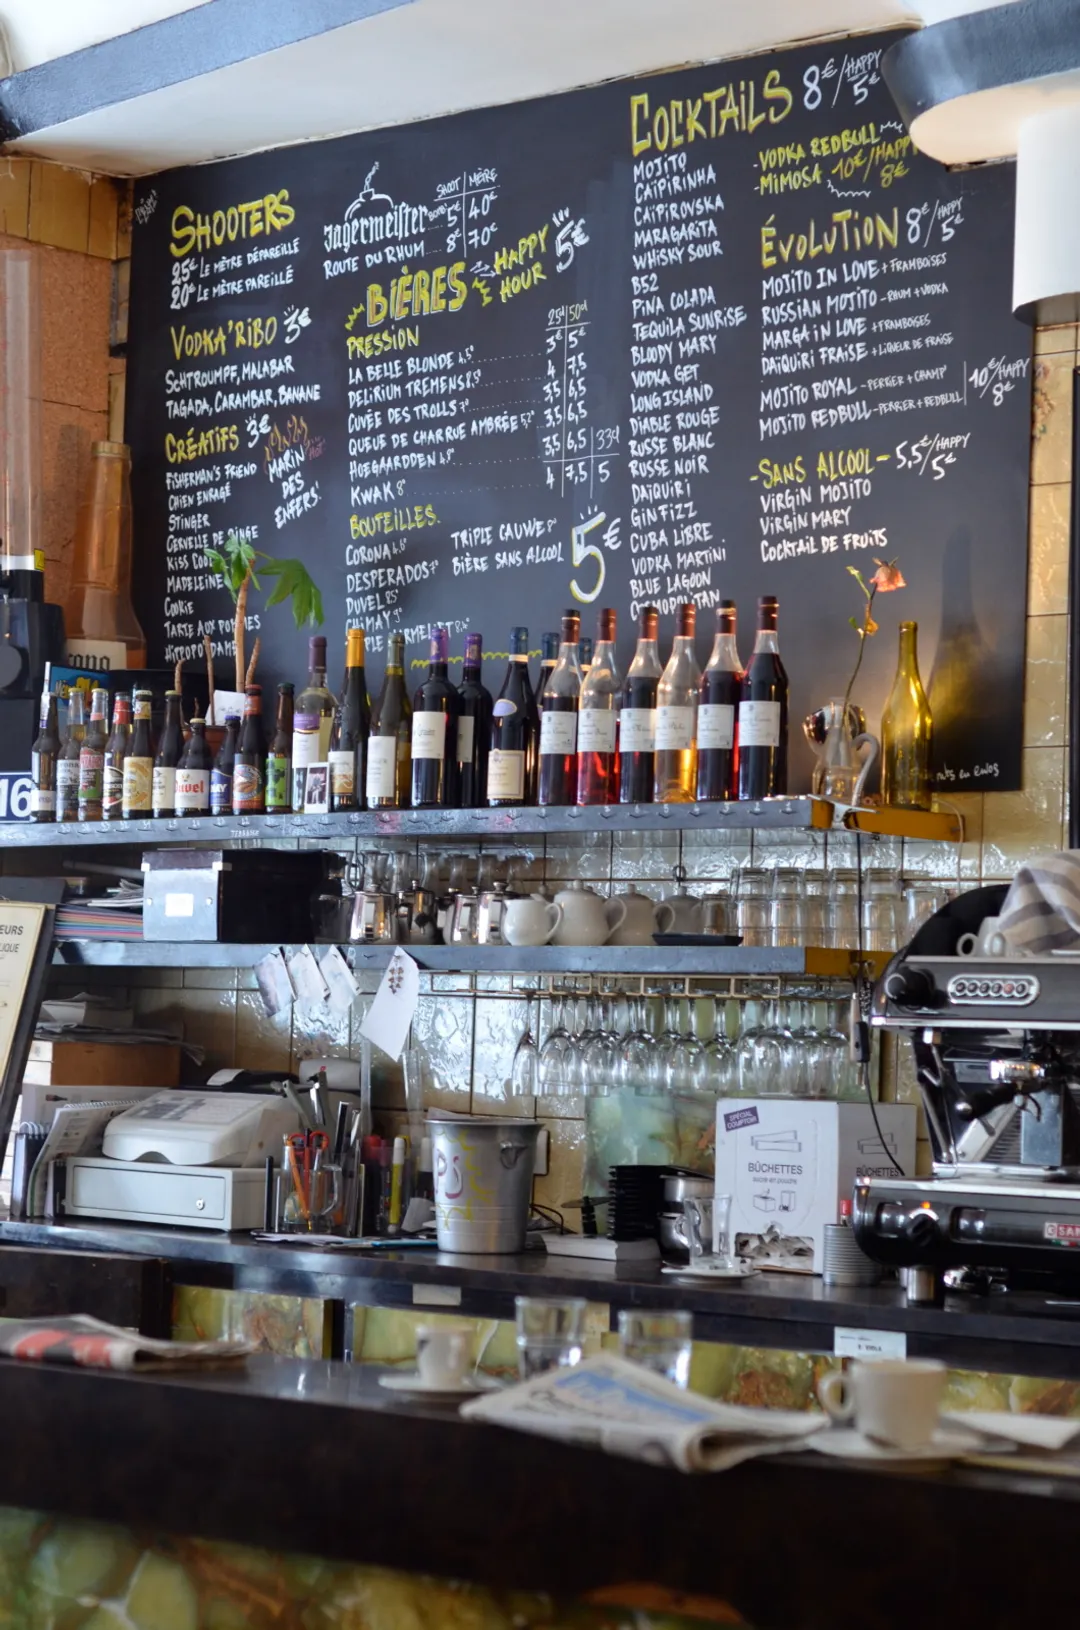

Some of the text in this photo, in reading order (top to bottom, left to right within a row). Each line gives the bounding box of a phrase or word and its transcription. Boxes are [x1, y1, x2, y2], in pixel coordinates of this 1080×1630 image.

[630, 70, 793, 157] COCKTAILS
[634, 151, 687, 183] MOJITO
[437, 177, 461, 199] SHOOT
[170, 189, 296, 257] SHOOTERS
[323, 257, 359, 280] ROUTE
[366, 252, 383, 267] DU
[385, 240, 425, 263] RHUM
[494, 223, 549, 275] HAPPY
[633, 240, 723, 270] WHISKY SOUR
[500, 261, 547, 303] HOUR
[631, 273, 659, 296] B52
[761, 268, 812, 300] MOJITO
[816, 268, 837, 289] IN
[842, 259, 880, 284] LOVE
[366, 261, 468, 328] BIÈRES
[670, 286, 716, 311] COLADA
[826, 287, 878, 315] MOJITO
[835, 317, 867, 339] LOVE
[346, 325, 420, 360] PRESSION
[631, 334, 717, 366] BLOODY MARY
[242, 355, 295, 381] MALABAR
[348, 365, 363, 386] LA
[366, 360, 403, 382] BELLE
[407, 351, 455, 375] BLONDE
[631, 363, 700, 388] VODKA GET
[278, 384, 320, 405] BANANE
[405, 376, 464, 398] TREMENS
[630, 384, 713, 414] LONG ISLAND
[760, 384, 808, 413] MOJITO
[812, 376, 858, 400] ROYAL
[348, 398, 458, 434] CUVÉE DES TROLLS
[676, 406, 720, 430] ROUGE
[759, 411, 806, 441] MOJITO
[811, 400, 872, 429] REDBULL
[348, 412, 519, 458] QUEUE DE CHARRUE AMBRÉE
[628, 431, 715, 457] RUSSE BLANC
[628, 455, 709, 478] RUSSE NOIR
[759, 448, 876, 489] SANS ALCOOL
[282, 471, 305, 499] DES
[351, 481, 396, 507] KWAK
[820, 478, 872, 499] MOJITO
[811, 505, 852, 530] MARY
[345, 544, 392, 567] CORONA
[495, 550, 523, 571] SANS
[525, 542, 565, 565] ALCOOL
[630, 532, 669, 553] CUBA
[760, 528, 888, 562] COCKTAIL DE FRUITS
[346, 561, 430, 594] DESPERADOS
[631, 554, 672, 576] VODKA
[630, 567, 712, 598] BLUE LAGOON
[346, 593, 385, 616] DUVEL
[197, 619, 216, 637] AUX
[748, 1161, 803, 1175] BÛCHETTES
